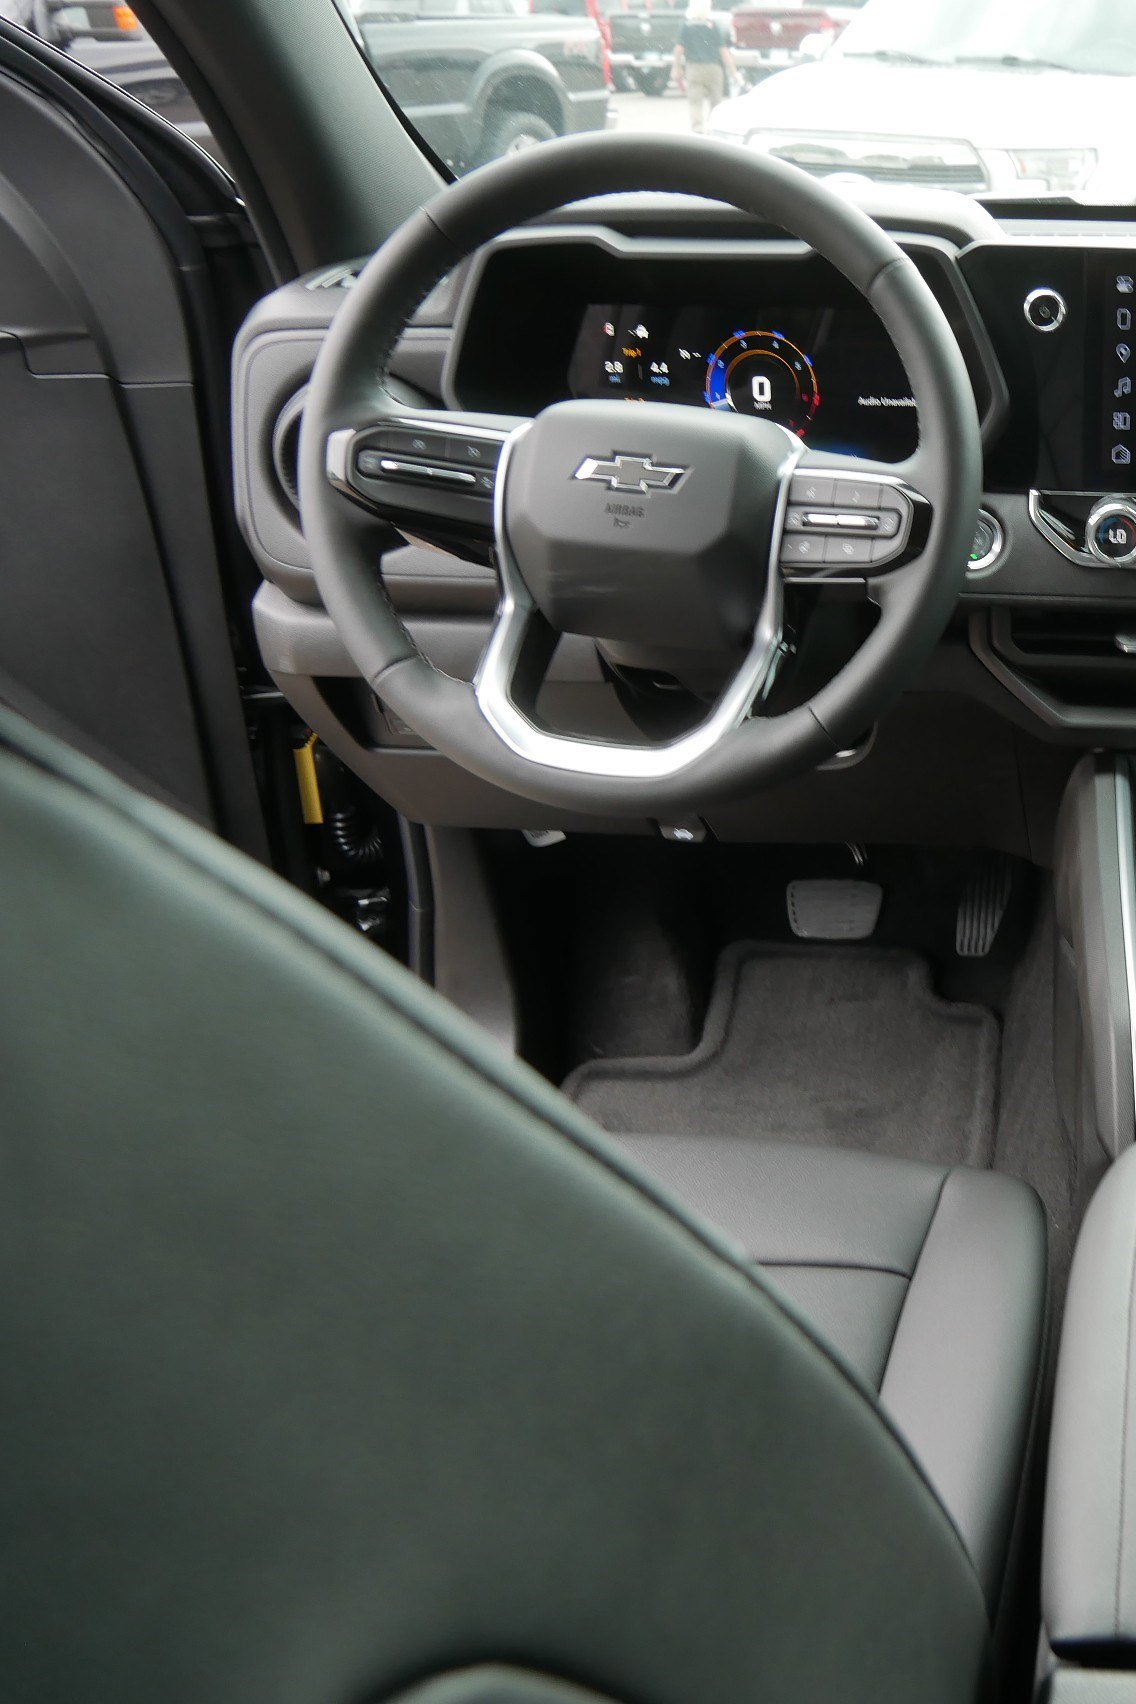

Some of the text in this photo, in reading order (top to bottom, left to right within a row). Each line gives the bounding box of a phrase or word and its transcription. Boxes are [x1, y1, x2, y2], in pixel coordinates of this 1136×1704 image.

[752, 375, 772, 402] 0
[858, 396, 881, 407] Audio
[604, 503, 645, 517] AIRBAG
